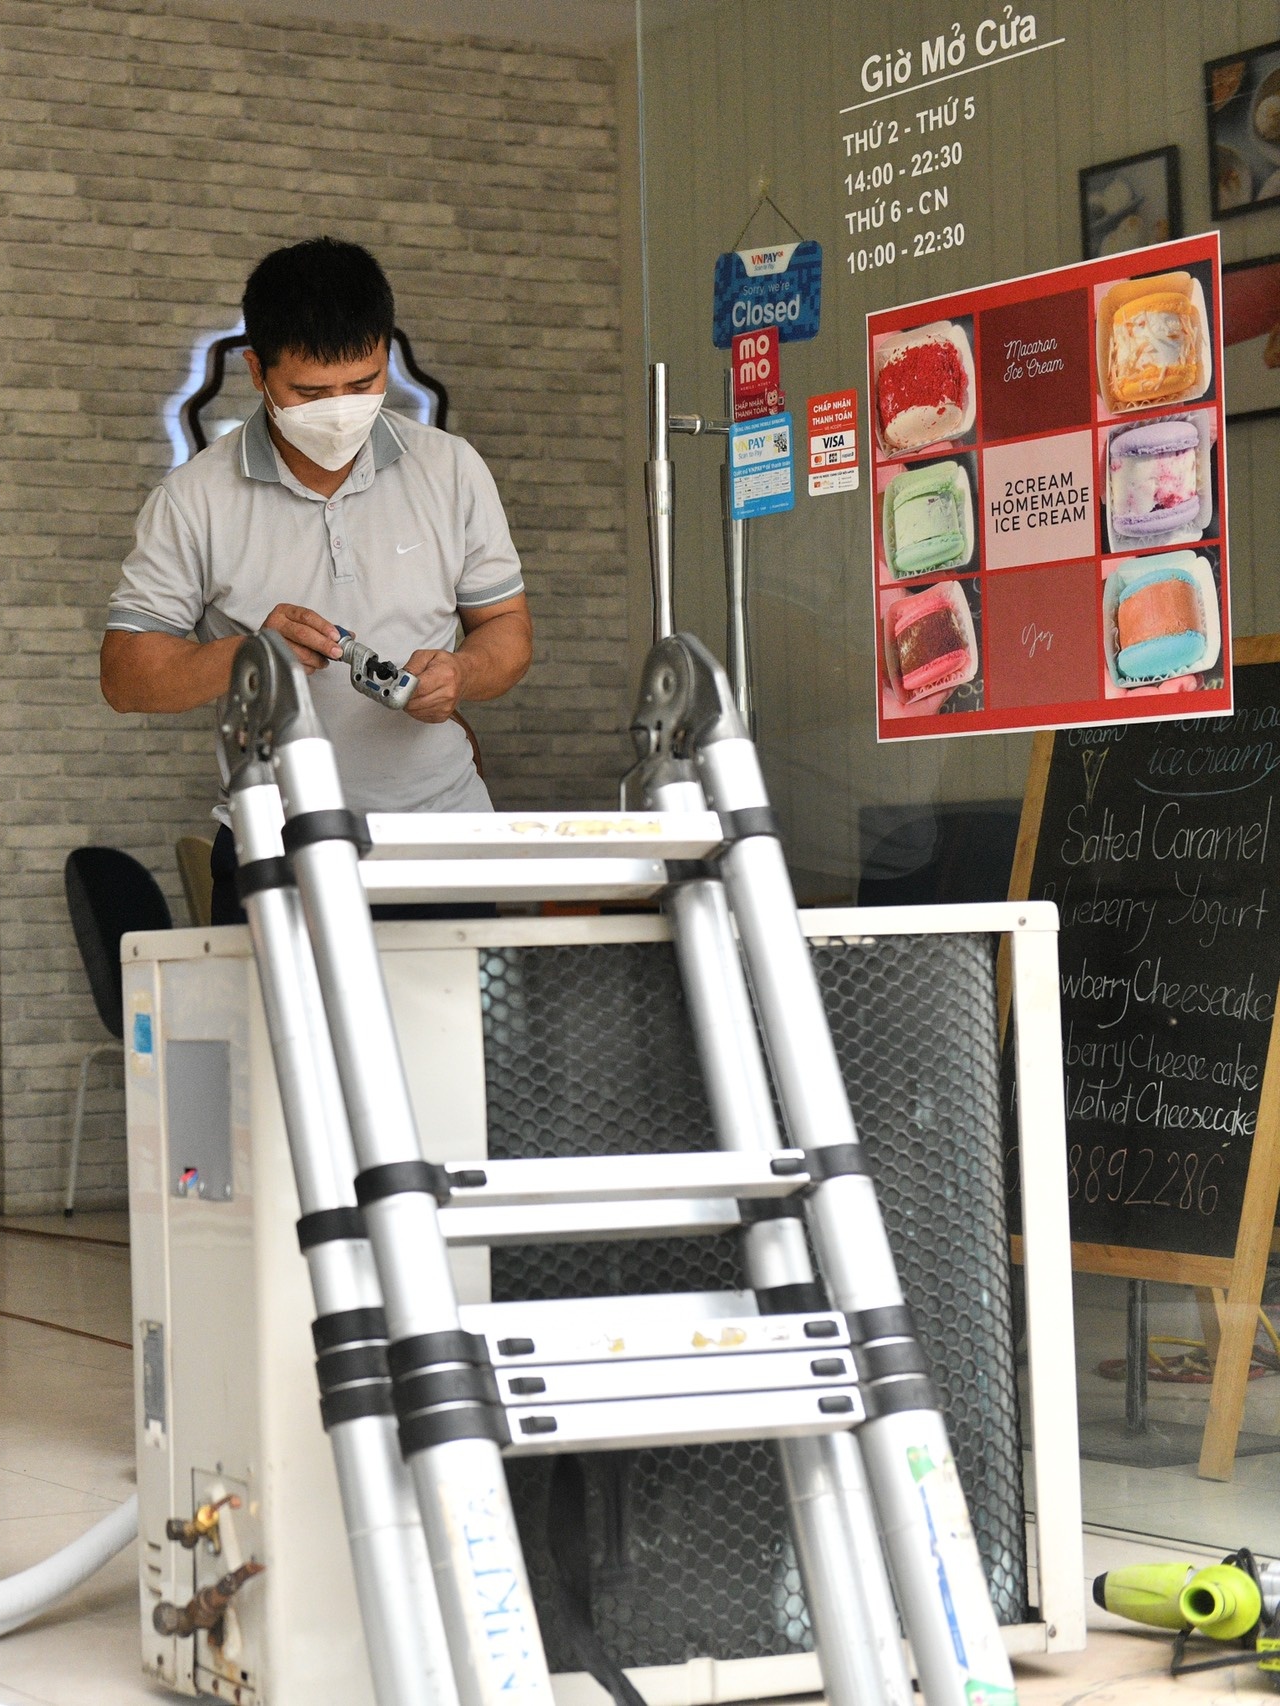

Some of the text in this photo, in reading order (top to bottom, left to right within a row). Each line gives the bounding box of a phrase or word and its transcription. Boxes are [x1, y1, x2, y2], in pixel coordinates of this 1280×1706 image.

[861, 5, 1037, 93] Giờ Mở Cửa
[842, 119, 884, 157] THỨ
[887, 120, 899, 144] 2
[916, 96, 959, 134] THỨ
[964, 96, 976, 120] 5
[844, 162, 894, 196] 14:00
[911, 142, 963, 177] 22:30
[845, 197, 886, 235] THỨ
[890, 200, 902, 223] 6
[919, 186, 949, 215] CN
[847, 241, 896, 274] 10:00
[913, 222, 965, 258] 22:30
[732, 294, 800, 328] Closed
[1004, 338, 1057, 361] Macaron
[1003, 358, 1064, 383] Ice Cream
[812, 410, 853, 426] THANH TOÁN
[813, 398, 851, 413] CHẤP NHẬN
[822, 434, 845, 449] VISA
[991, 487, 1090, 516] HOMEMADE
[1005, 471, 1073, 497] 2CREAM
[995, 505, 1086, 533] ICE CREAM
[1148, 741, 1183, 775] ice
[1061, 795, 1273, 865] Salted Caramel
[1168, 871, 1269, 948] Yogurt
[1061, 956, 1275, 1029] wberry Cheesecake
[1062, 1019, 1126, 1089] berry
[1135, 1080, 1258, 1137] Cheesecake
